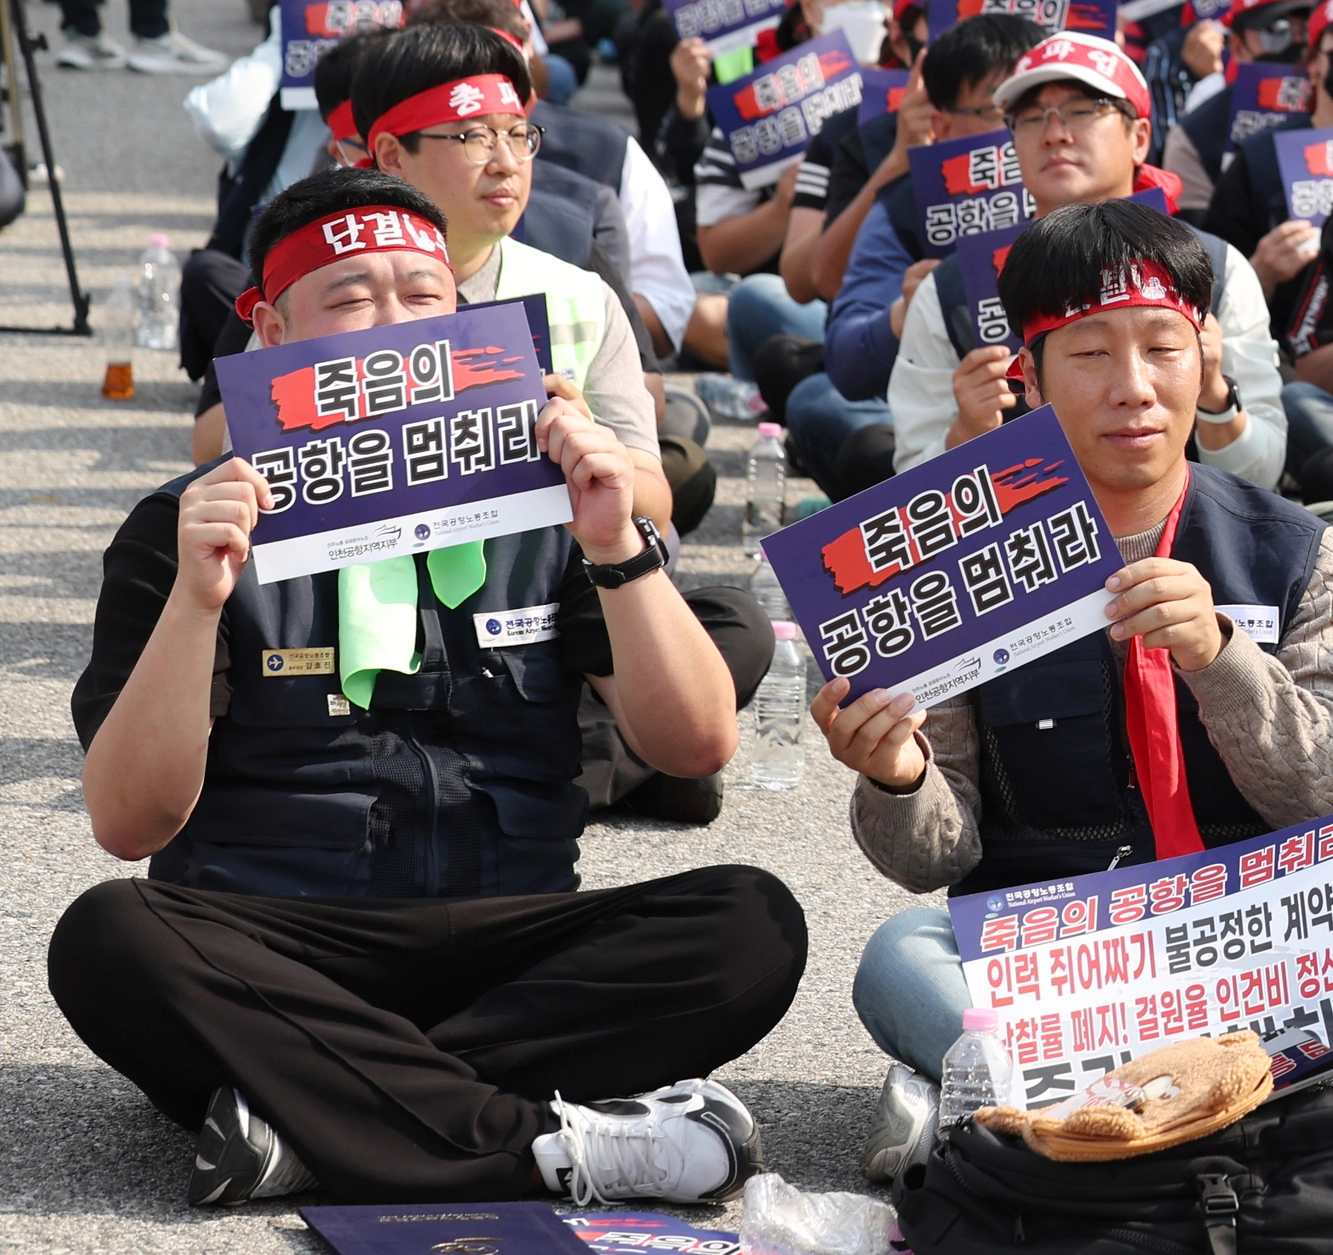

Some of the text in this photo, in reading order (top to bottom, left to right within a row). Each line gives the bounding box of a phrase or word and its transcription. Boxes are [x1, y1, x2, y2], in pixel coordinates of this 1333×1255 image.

[314, 339, 453, 422] 죽음의
[252, 428, 395, 515] 공항을
[328, 537, 398, 561] 인천공항지역지부
[859, 463, 1004, 574] 죽음의
[817, 500, 1102, 679] 공항을 멈춰라
[1235, 618, 1274, 629] 노동조합
[915, 669, 981, 704] 인천공항지역지부
[980, 897, 1098, 953] 죽음의
[1108, 862, 1228, 924] 공항을
[1005, 882, 1074, 901] 전국공항노동조합
[986, 954, 1041, 1008] 인력
[1050, 932, 1157, 996] 쥐어짜기
[1165, 901, 1274, 975] 불공정한
[1072, 1002, 1127, 1053] 폐지!
[1135, 983, 1205, 1041] 결원율
[1216, 961, 1290, 1021] 인건비
